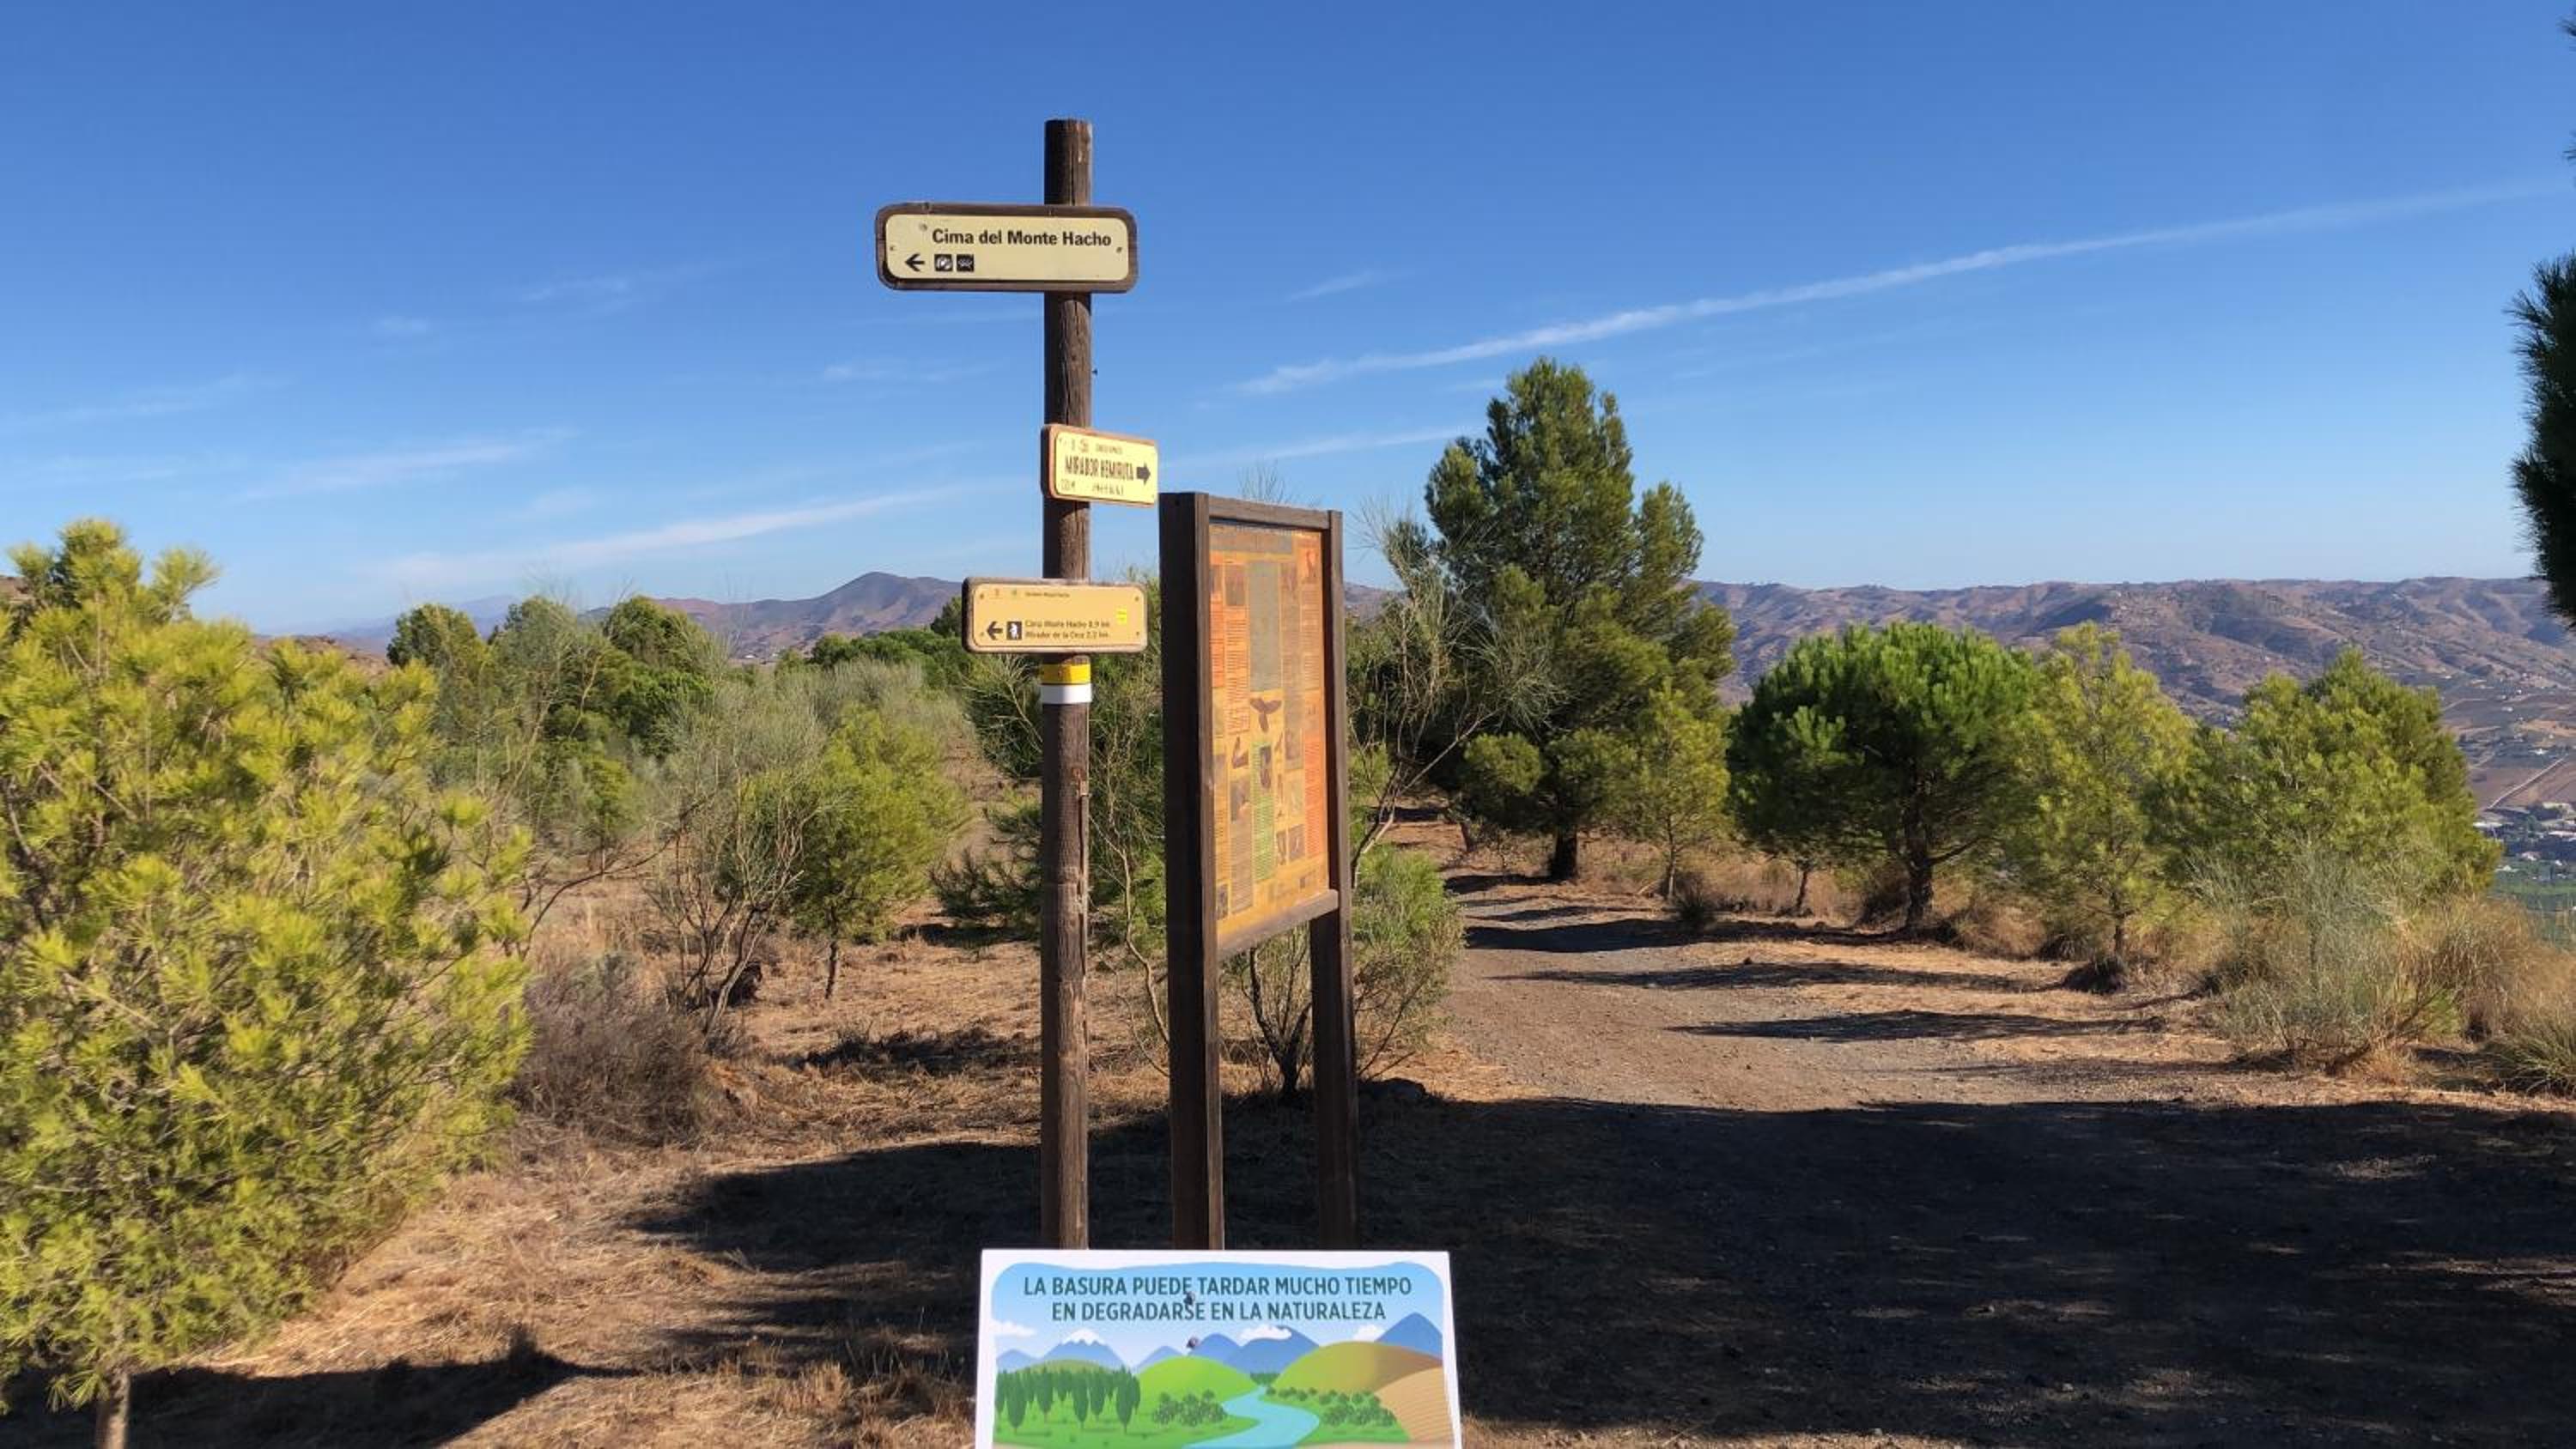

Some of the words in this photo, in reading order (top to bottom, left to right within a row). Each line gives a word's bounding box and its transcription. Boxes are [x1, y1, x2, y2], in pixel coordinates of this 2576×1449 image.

[933, 228, 975, 245] Cima
[979, 230, 1002, 245] del
[1007, 230, 1058, 246] Monte
[1062, 231, 1112, 246] Hacho
[1065, 455, 1099, 477] MIRADOR
[1070, 631, 1084, 640] Cruz
[1024, 1276, 1046, 1295] LA
[1052, 1276, 1127, 1295] BASURA
[1133, 1276, 1192, 1295] PUEDE
[1197, 1276, 1270, 1295] TARDAR
[1275, 1276, 1340, 1295] MUCHO
[1345, 1276, 1412, 1295] TIEMPO
[1052, 1302, 1076, 1321] EN
[1081, 1302, 1206, 1321] DEGRADARSE
[1211, 1301, 1234, 1320] EN
[1240, 1301, 1262, 1320] LA
[1267, 1301, 1387, 1320] NATURALEZA
